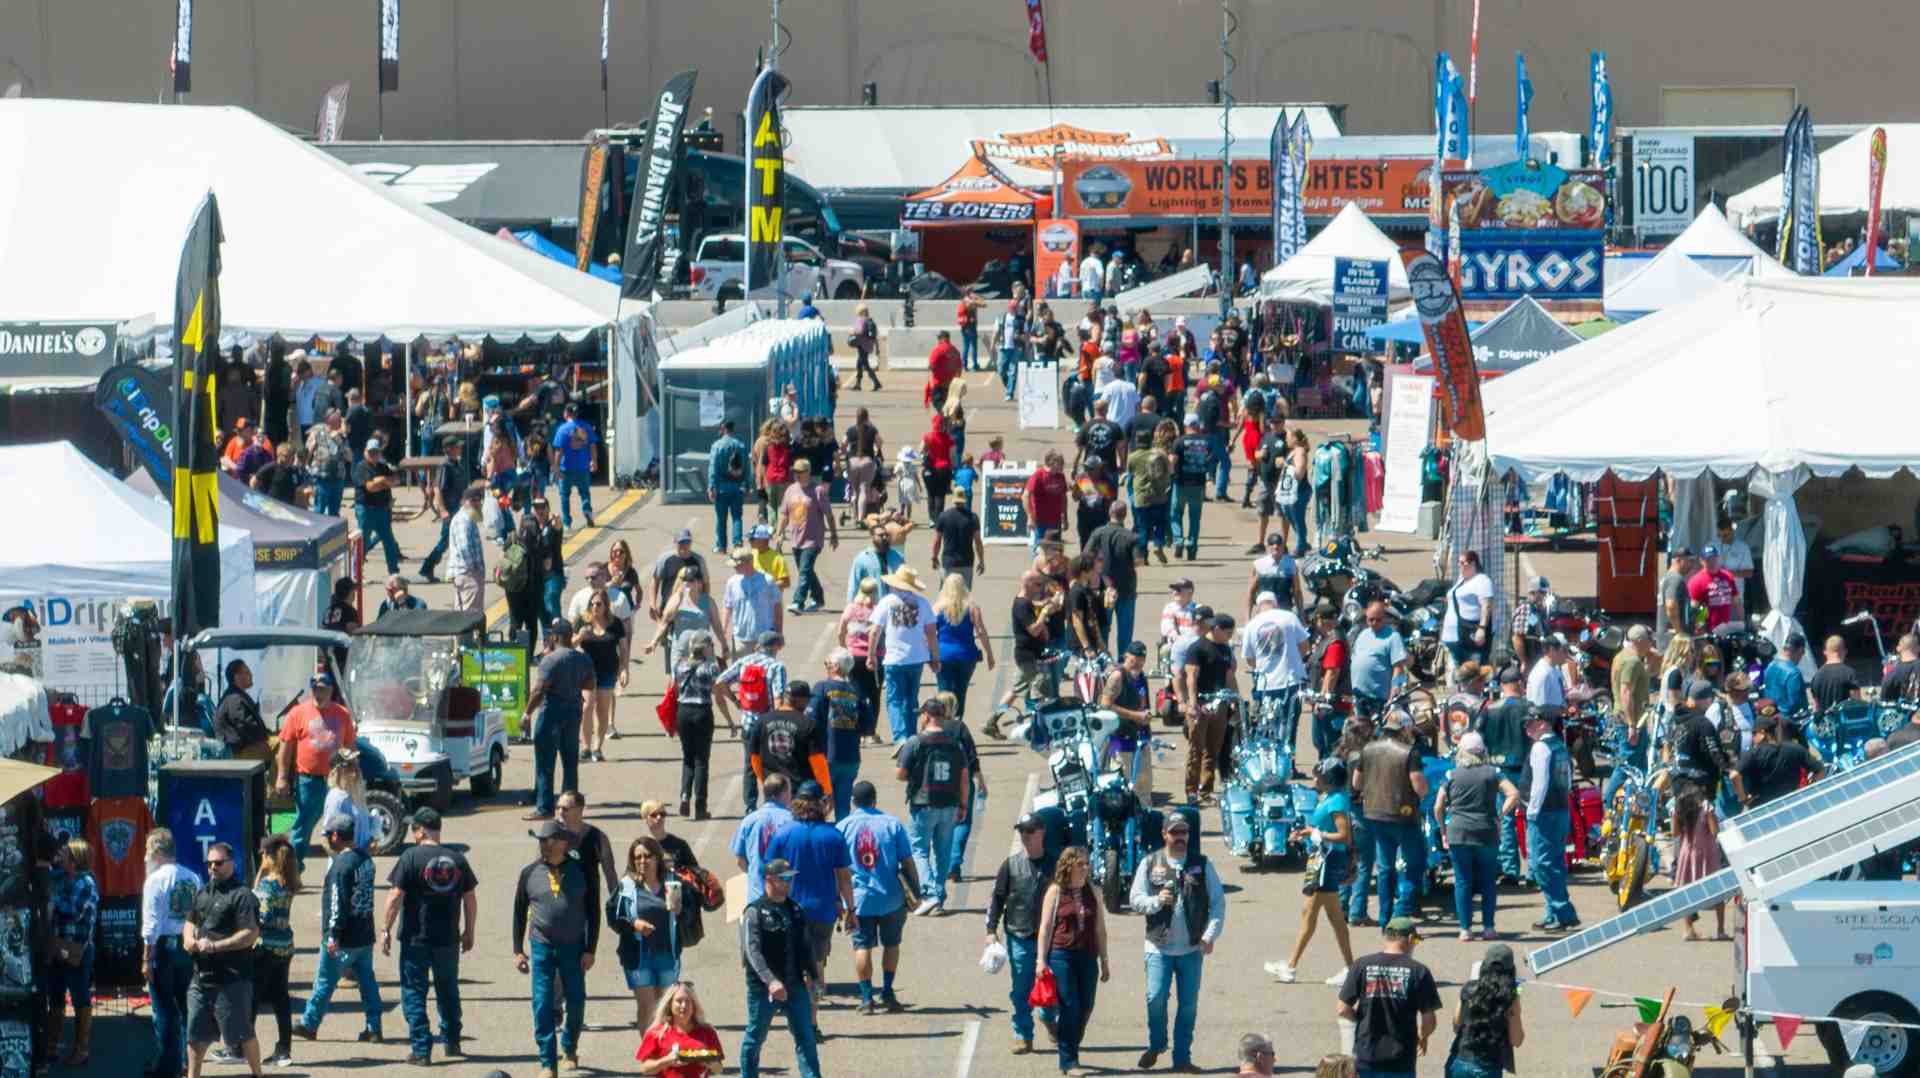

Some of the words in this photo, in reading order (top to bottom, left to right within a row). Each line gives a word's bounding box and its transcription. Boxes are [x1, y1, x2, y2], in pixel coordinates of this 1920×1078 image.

[652, 91, 684, 152] JACK
[752, 110, 783, 243] ATM
[1257, 165, 1388, 191] BHTEST
[950, 203, 1033, 219] COVERS
[0, 330, 74, 355] DANIEL'S
[1342, 335, 1376, 351] CAKE
[1499, 349, 1547, 361] Dignity
[194, 798, 217, 864] AT
